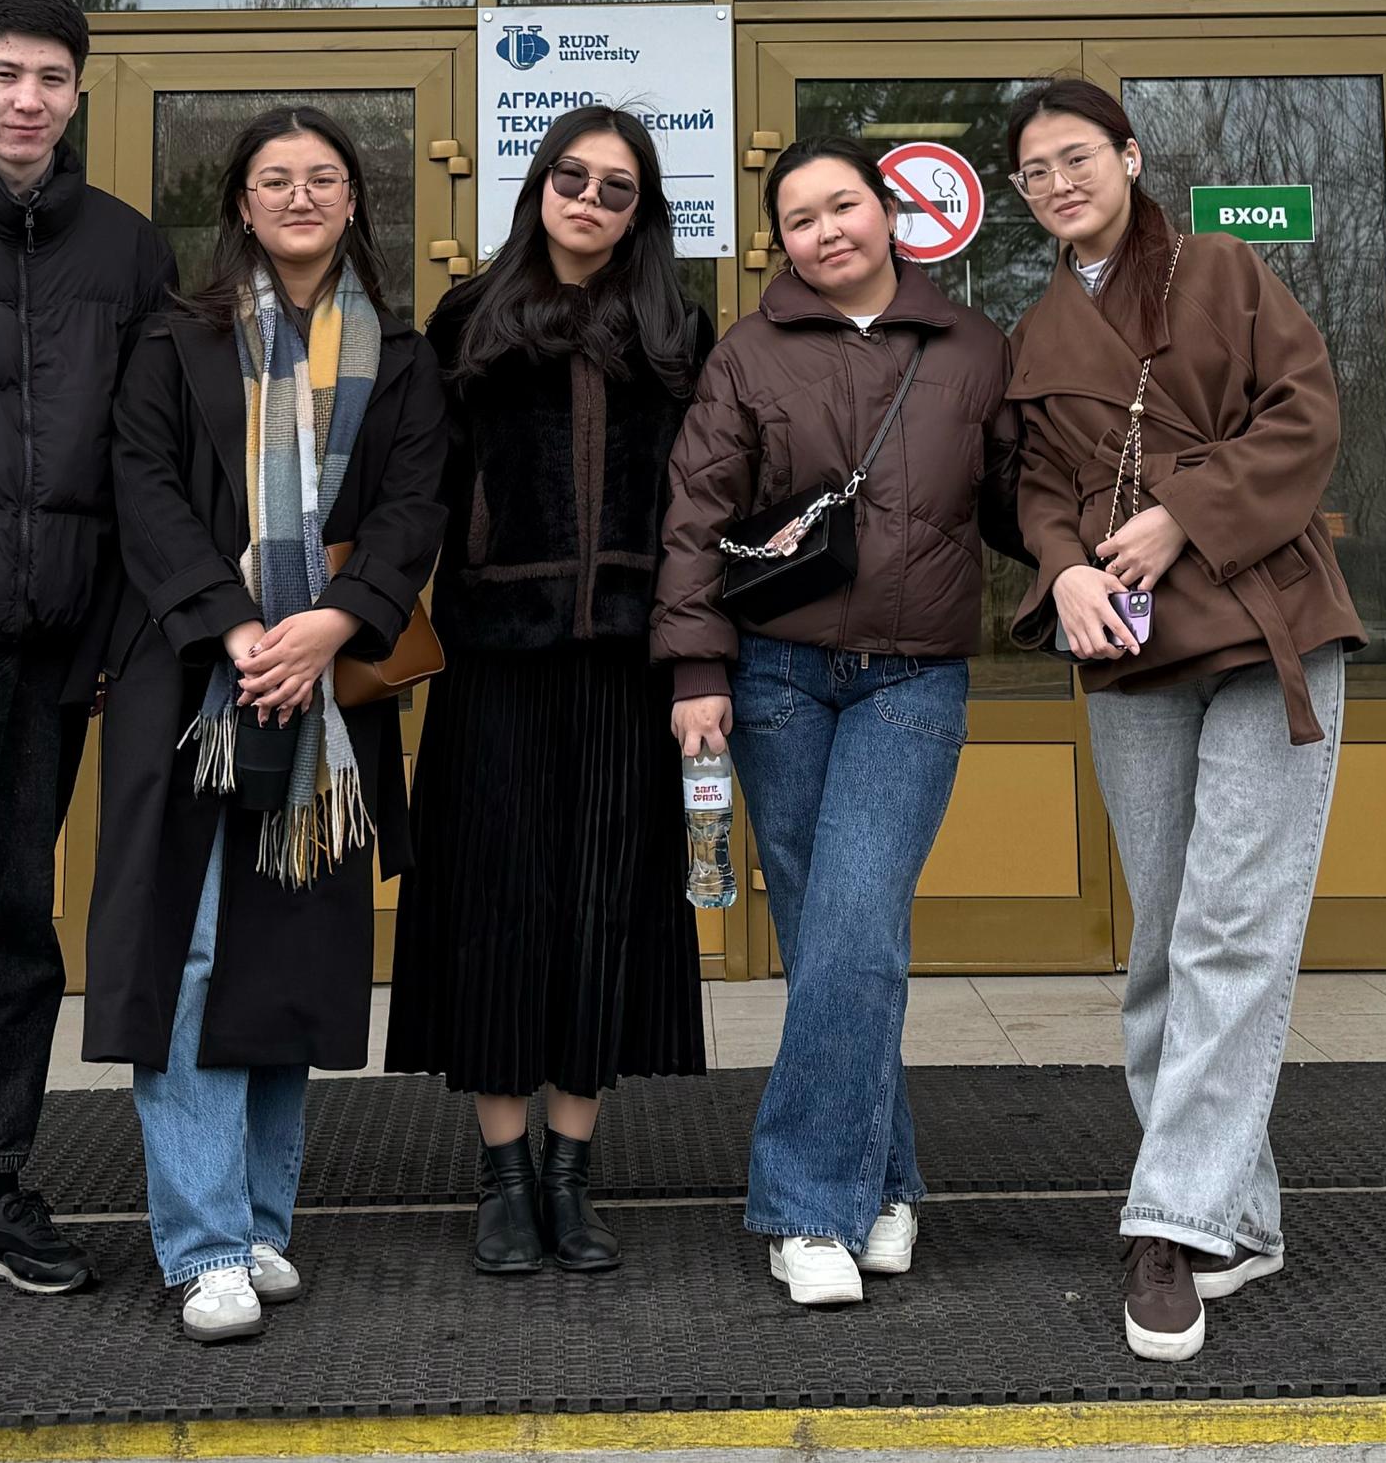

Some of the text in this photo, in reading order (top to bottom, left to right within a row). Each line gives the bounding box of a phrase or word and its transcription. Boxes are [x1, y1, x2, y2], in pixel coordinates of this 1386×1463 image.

[558, 35, 609, 48] RUDN
[559, 47, 640, 64] university
[497, 91, 603, 109] АГРАРНО-
